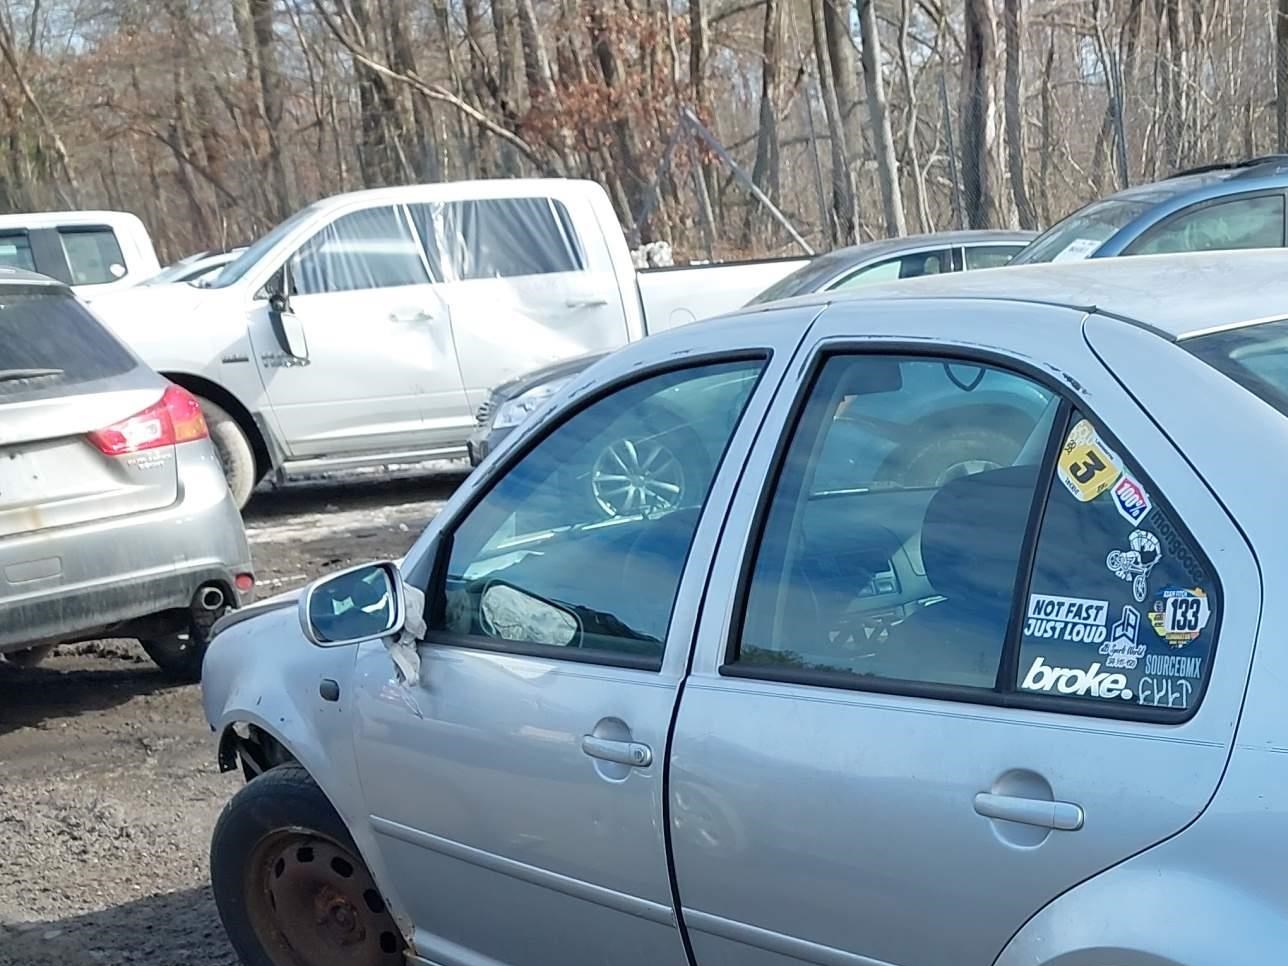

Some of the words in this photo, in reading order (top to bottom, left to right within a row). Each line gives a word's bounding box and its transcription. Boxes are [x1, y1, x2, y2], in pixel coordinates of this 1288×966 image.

[1069, 450, 1107, 484] 3
[1116, 482, 1148, 518] 100%
[1033, 599, 1064, 618] NOT
[1067, 602, 1104, 623] FAST
[1170, 598, 1201, 631] 133
[1025, 619, 1065, 640] JUST
[1065, 623, 1107, 643] LOUD
[1022, 657, 1133, 700] broke.
[1145, 655, 1202, 679] SOURCEBMX
